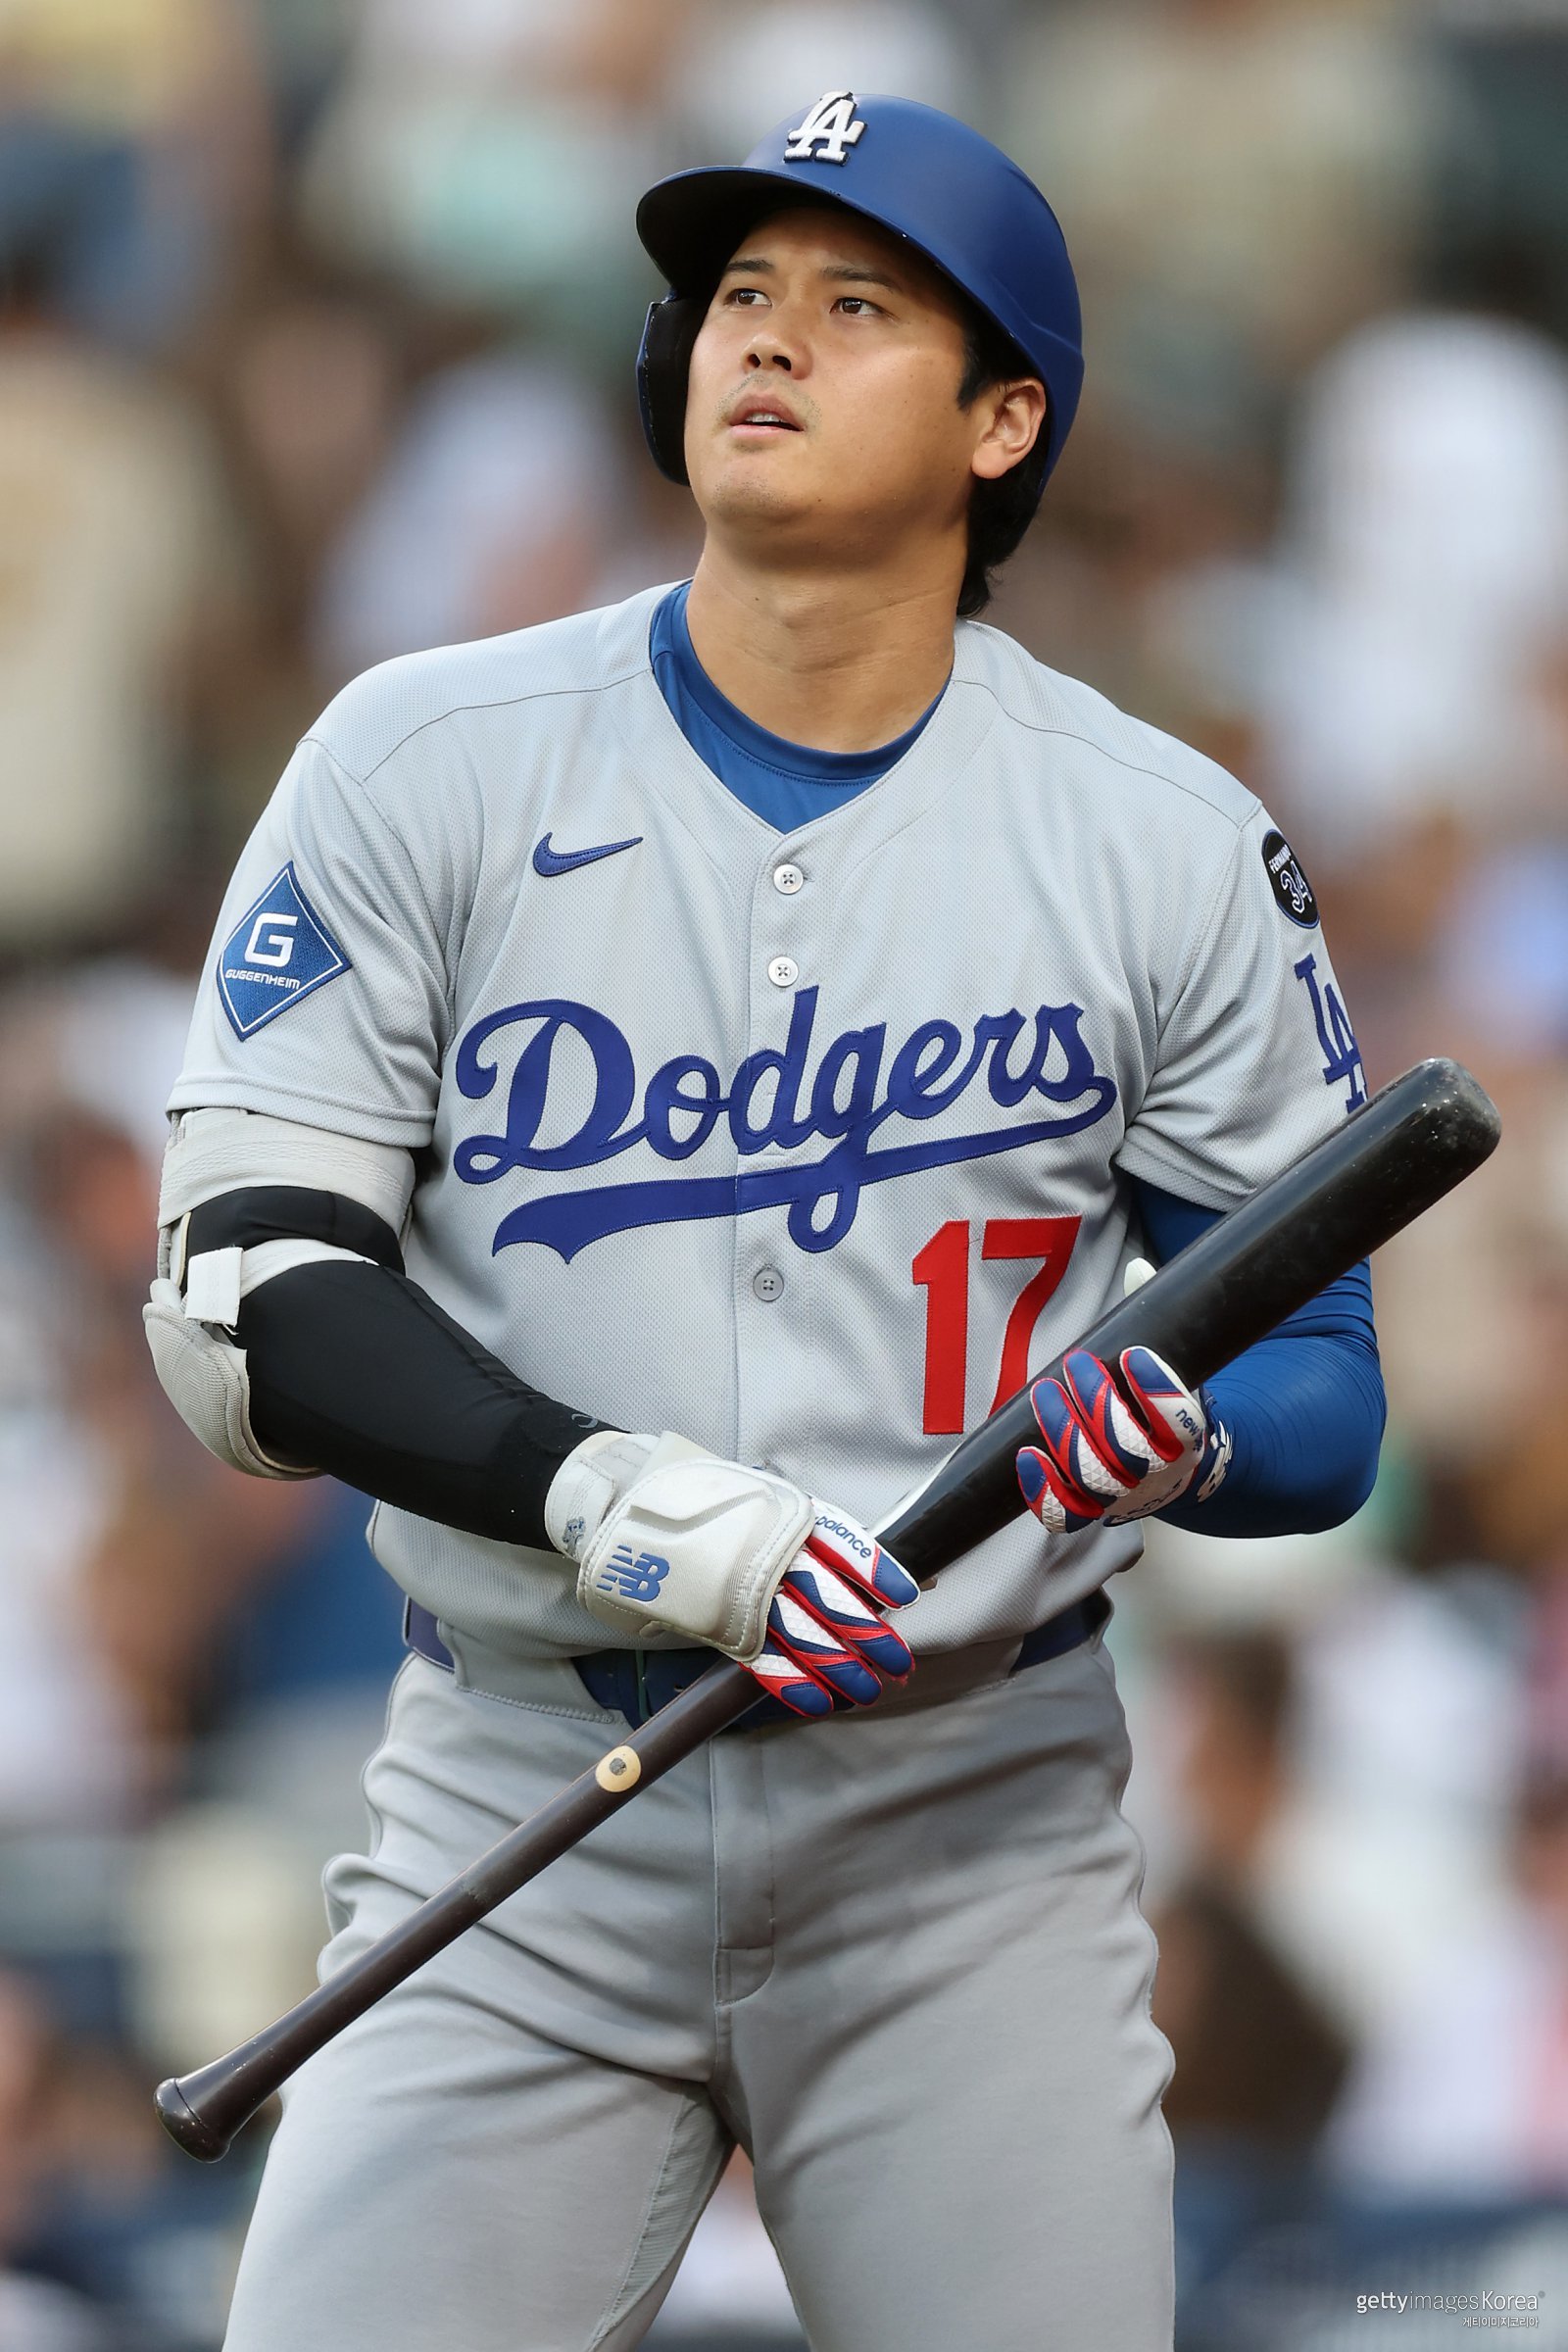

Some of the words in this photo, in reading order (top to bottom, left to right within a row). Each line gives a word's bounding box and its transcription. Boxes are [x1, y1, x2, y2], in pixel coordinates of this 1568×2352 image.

[784, 90, 867, 165] LA
[225, 968, 301, 990] GUGGENHEIM
[245, 913, 298, 967] G
[1294, 953, 1368, 1114] LA
[454, 985, 1116, 1253] Dodgers
[912, 1215, 1082, 1434] 17
